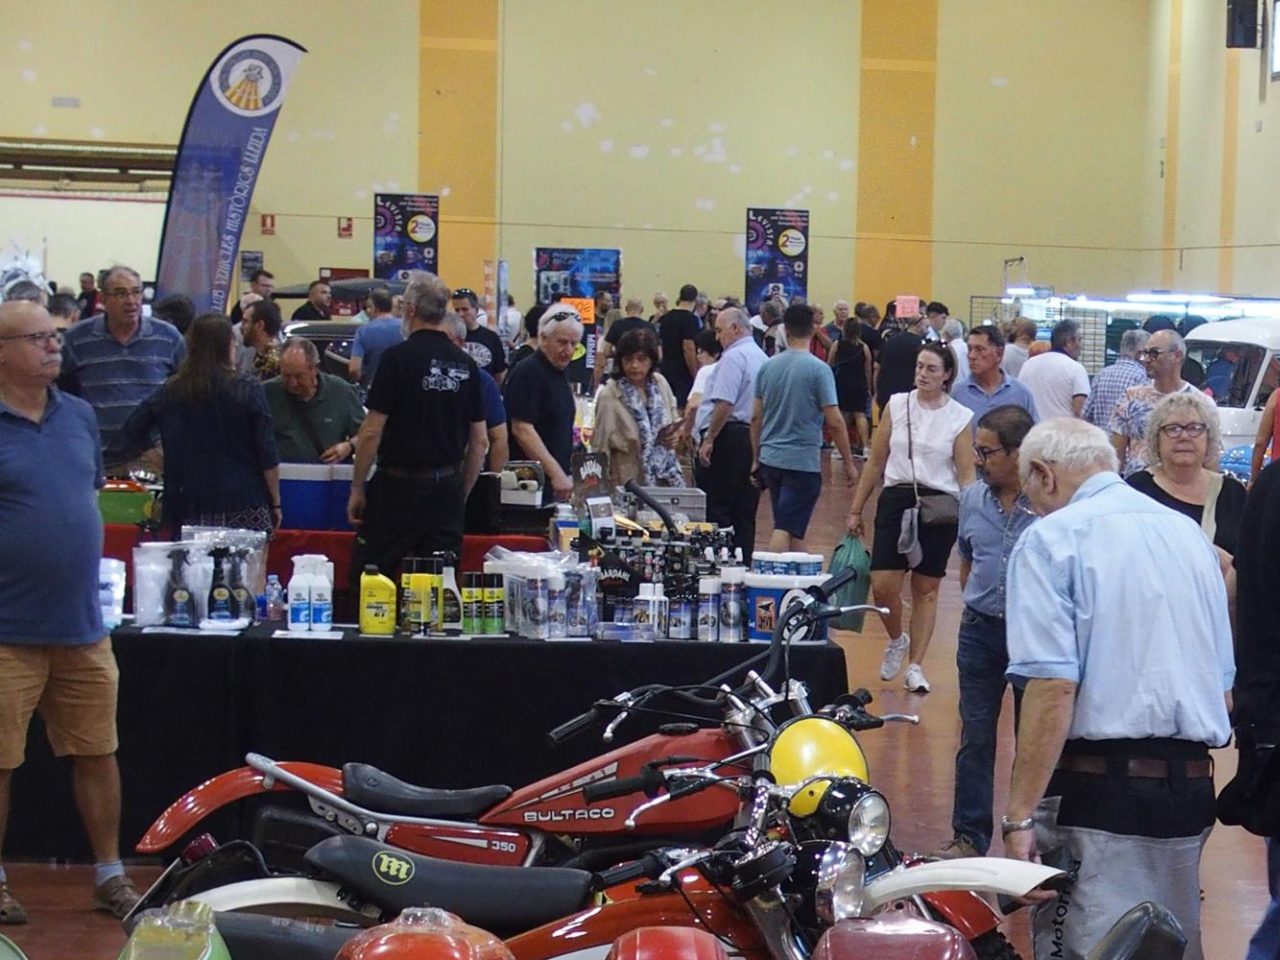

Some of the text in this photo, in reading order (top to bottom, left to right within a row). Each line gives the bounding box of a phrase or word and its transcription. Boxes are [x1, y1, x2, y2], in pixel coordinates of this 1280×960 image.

[215, 234, 236, 285] VEHICLES
[247, 127, 268, 164] LLEIDA
[410, 220, 419, 234] 2
[780, 234, 790, 248] 2
[524, 807, 615, 822] BULTACO
[492, 840, 516, 853] 350
